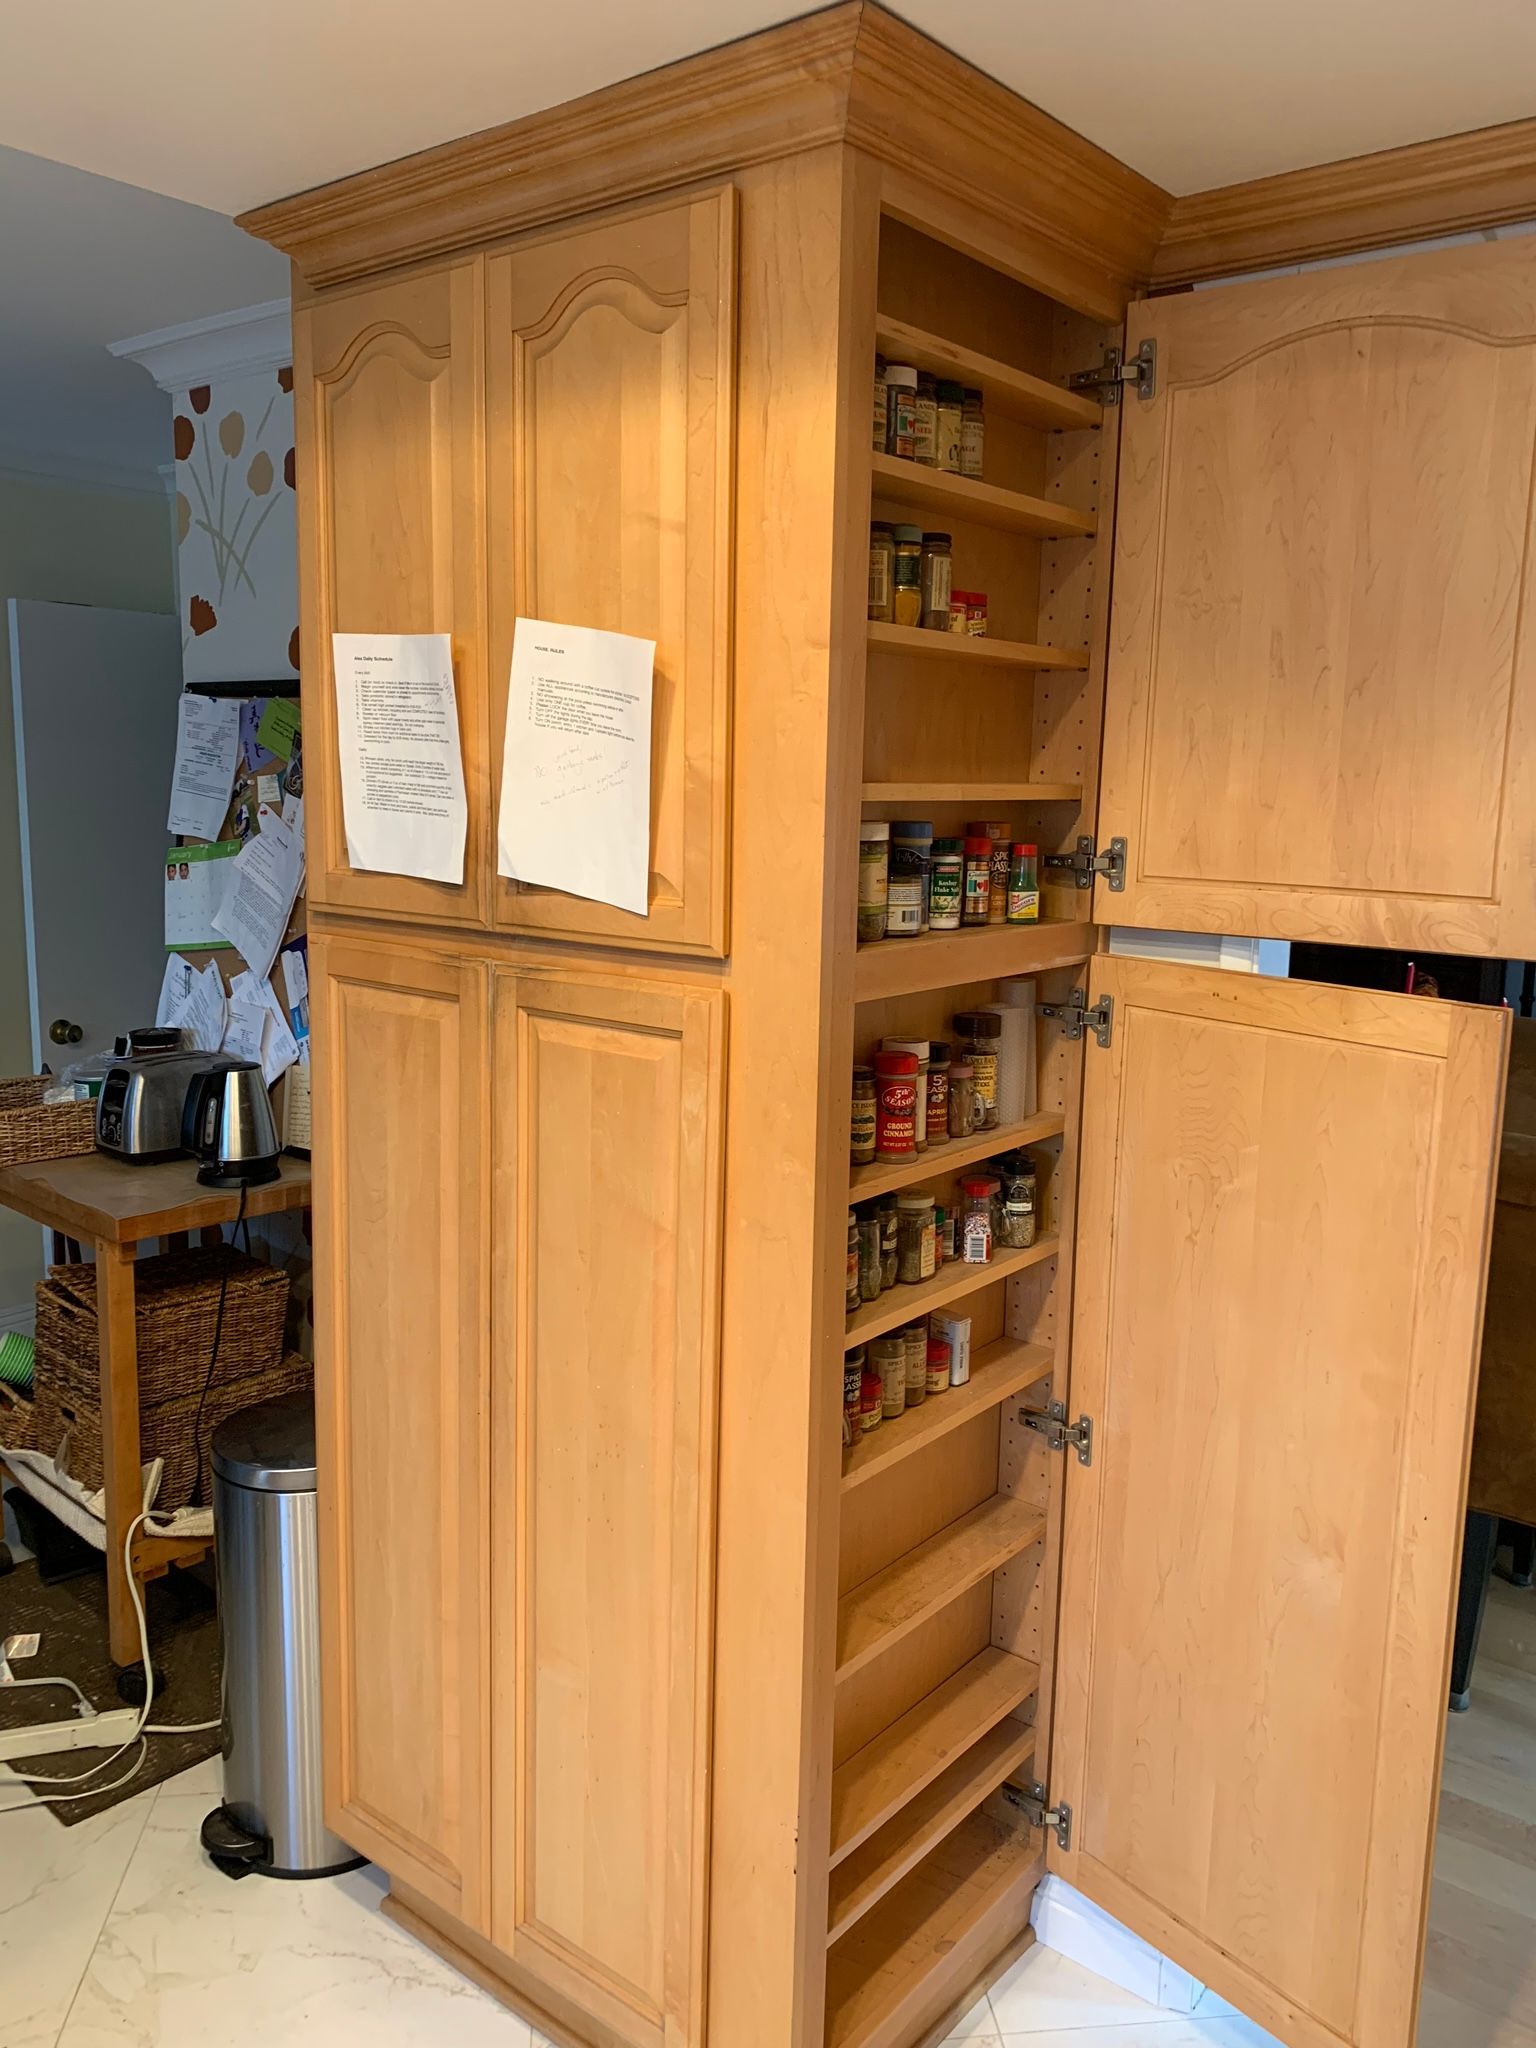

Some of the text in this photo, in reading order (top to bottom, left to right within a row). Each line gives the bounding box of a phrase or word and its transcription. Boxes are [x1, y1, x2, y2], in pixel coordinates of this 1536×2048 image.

[938, 879, 957, 887] Kosher
[895, 1088, 909, 1099] 5th
[884, 1094, 915, 1107] SEASON
[887, 1122, 912, 1130] GROUND
